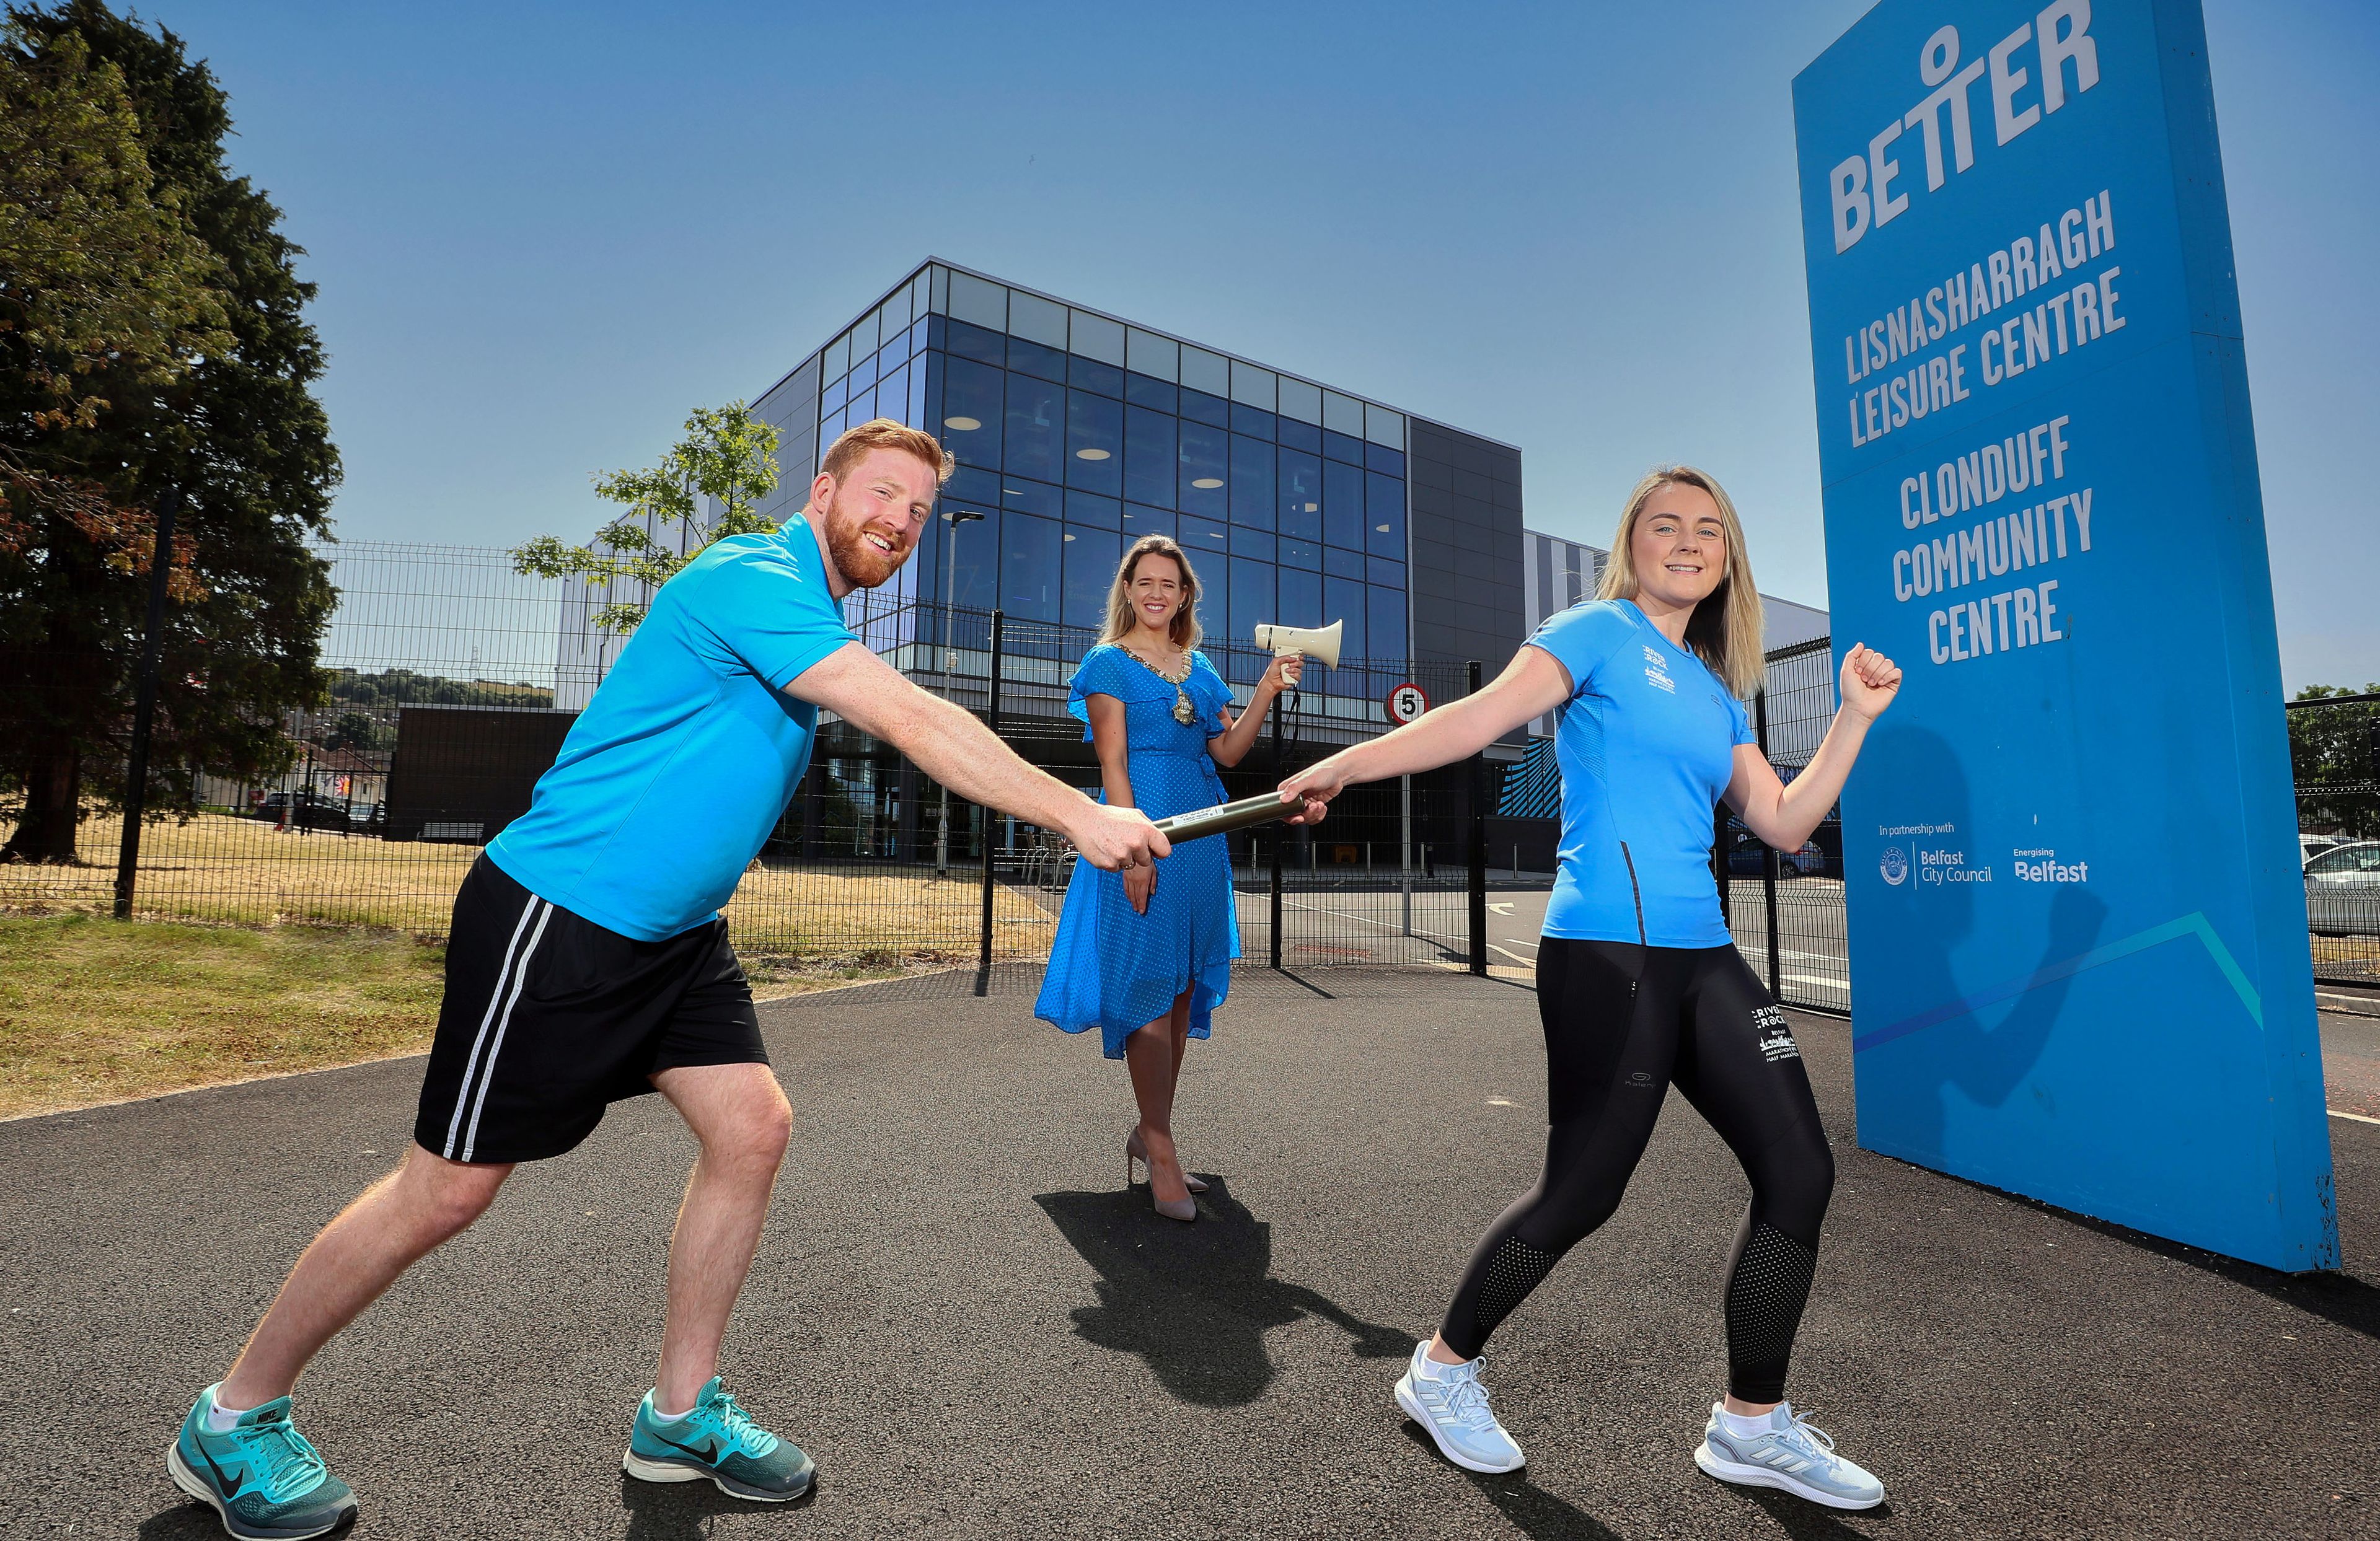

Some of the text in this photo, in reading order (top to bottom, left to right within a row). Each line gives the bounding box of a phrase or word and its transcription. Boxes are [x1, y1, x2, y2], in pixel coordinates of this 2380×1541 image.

[1830, 0, 2099, 255] BETTER
[1845, 189, 2115, 385] LISNASHARRAGH
[1849, 266, 2126, 448] LEISURE CENTRE
[1900, 415, 2069, 530] CLONDUFF
[1893, 488, 2093, 602] COMMUNITY
[1928, 579, 2063, 665] CENTRE
[1645, 646, 1666, 663] RIVER
[1646, 653, 1668, 670] ROCK
[1401, 694, 1416, 714] 5
[1879, 822, 1954, 838] In partnership with
[1921, 850, 1963, 865] Belfast
[2013, 848, 2054, 858] Energising
[1922, 866, 1992, 885] City Council
[2014, 860, 2088, 882] Belfast
[1761, 1016, 1786, 1027] ROCK
[257, 1408, 278, 1424] NIKE
